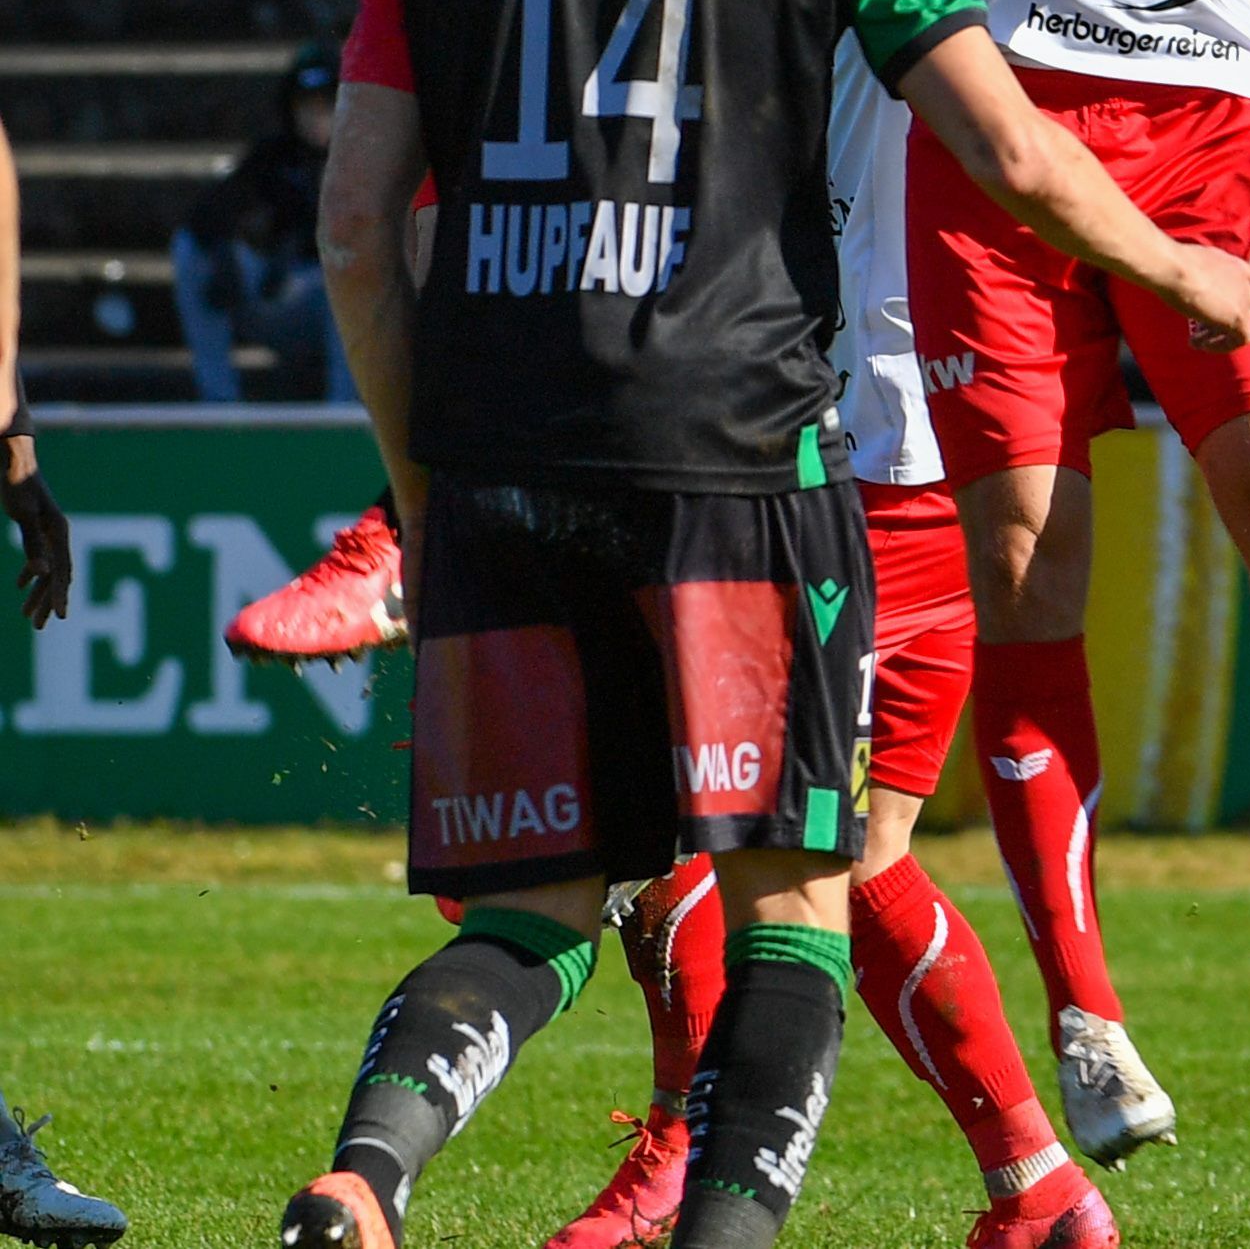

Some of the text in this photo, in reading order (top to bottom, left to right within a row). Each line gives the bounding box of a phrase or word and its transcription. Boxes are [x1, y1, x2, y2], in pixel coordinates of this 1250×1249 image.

[466, 200, 691, 298] HUPFAUF
[0, 512, 376, 736] EN
[859, 652, 880, 726] 1
[432, 782, 581, 848] TIWAG
